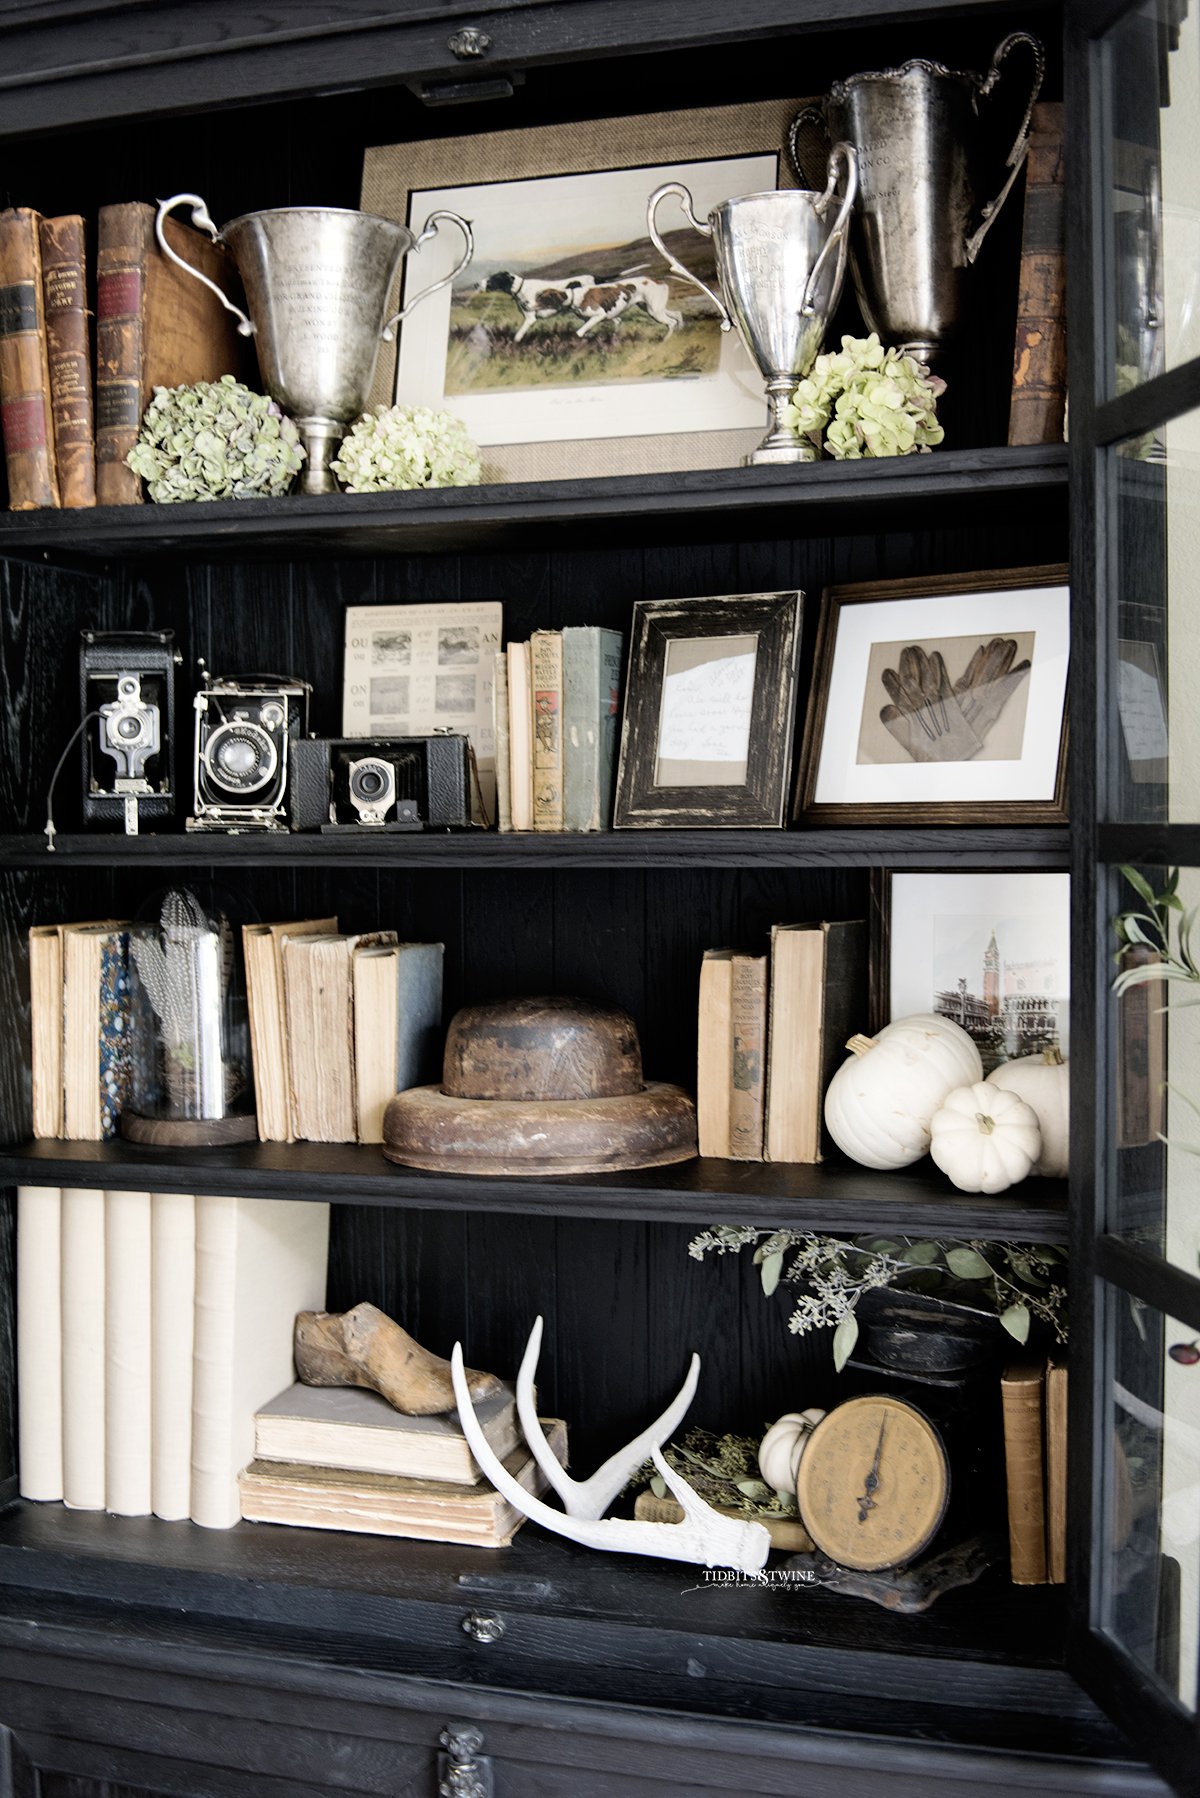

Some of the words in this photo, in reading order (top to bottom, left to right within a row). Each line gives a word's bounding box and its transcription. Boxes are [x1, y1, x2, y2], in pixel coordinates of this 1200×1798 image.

[482, 632, 499, 643] AN
[351, 638, 369, 649] OU
[350, 685, 368, 696] ON
